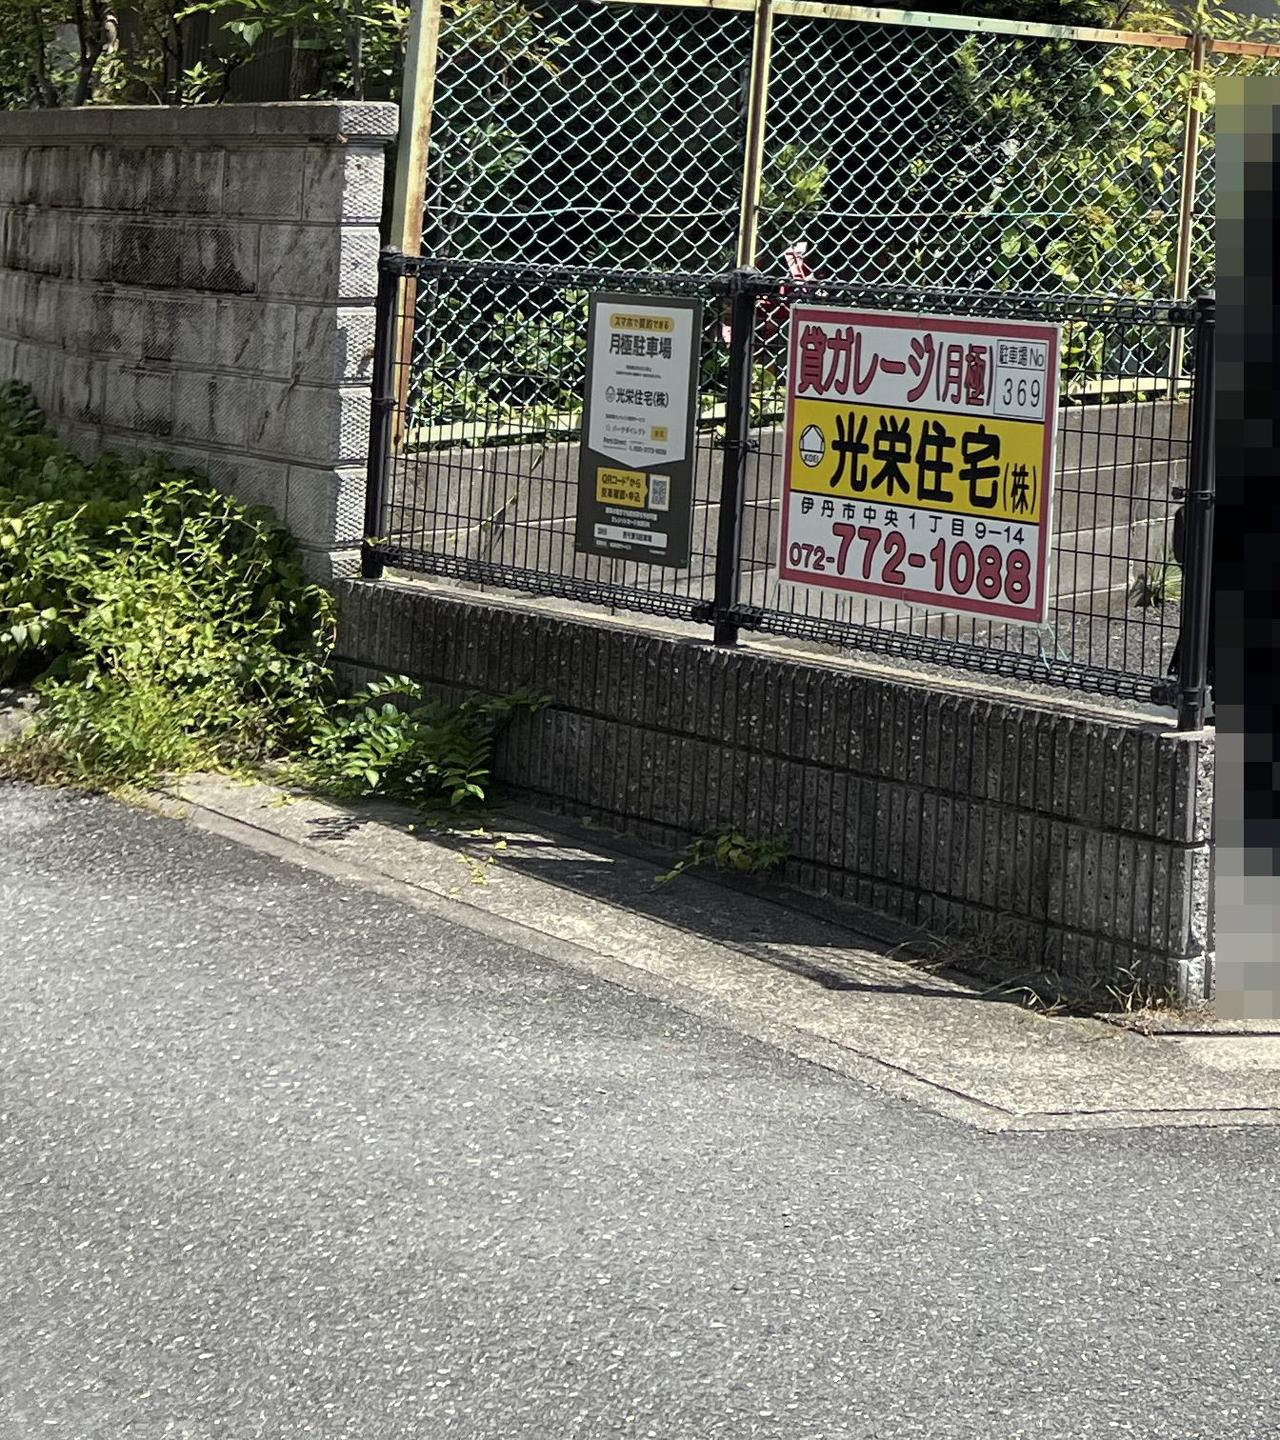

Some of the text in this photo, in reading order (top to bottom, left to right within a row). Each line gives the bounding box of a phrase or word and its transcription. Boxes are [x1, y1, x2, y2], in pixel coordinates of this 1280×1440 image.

[609, 334, 672, 359] 月極駐車場
[799, 325, 994, 406] 貸ガレージ(月極)
[616, 387, 669, 408] 光栄住宅(株)
[1003, 378, 1040, 407] 369
[830, 412, 1037, 515] 光栄住宅(株)
[790, 522, 1030, 604] 072-772-1088
